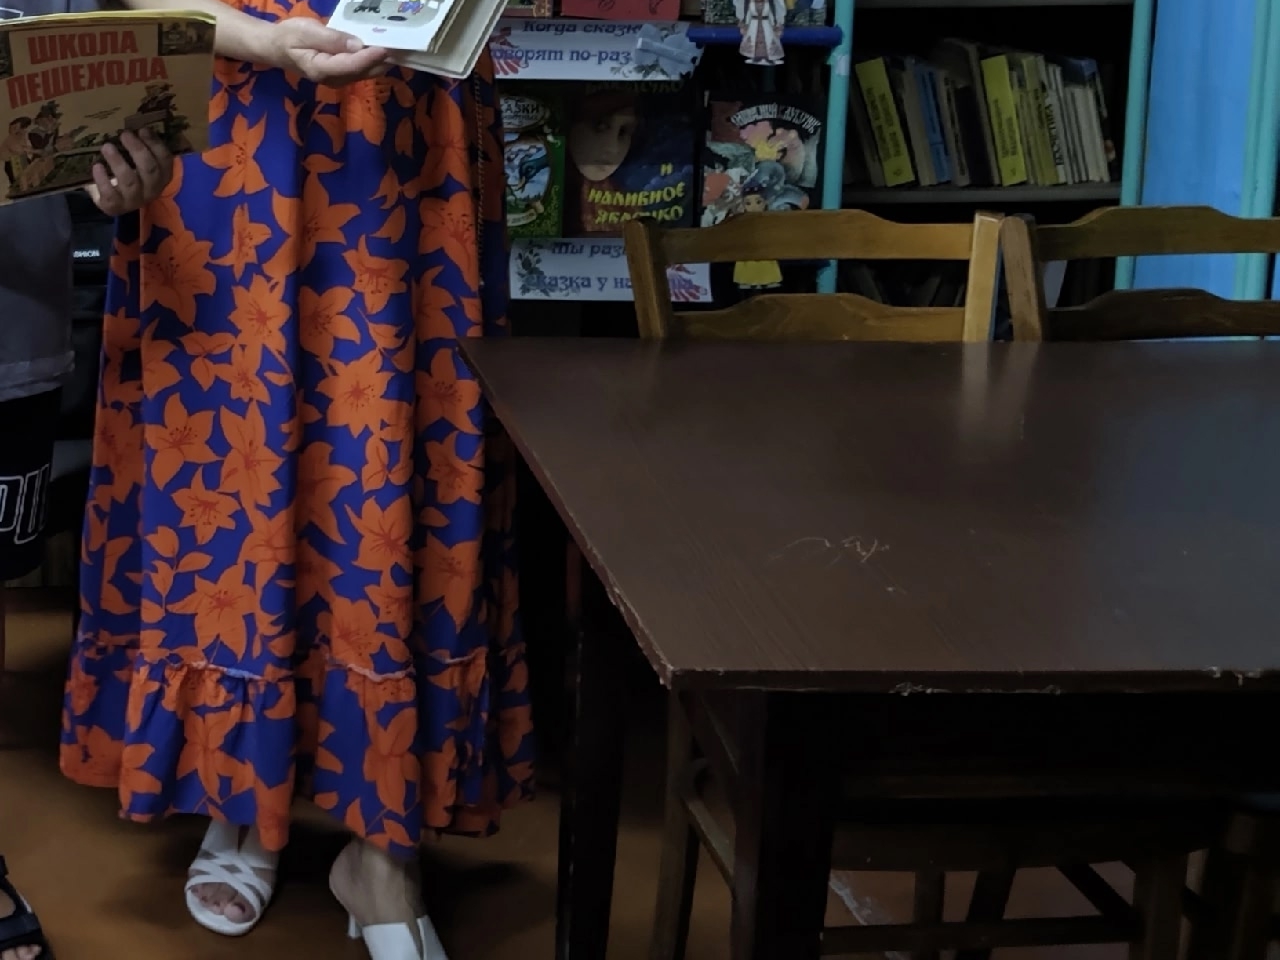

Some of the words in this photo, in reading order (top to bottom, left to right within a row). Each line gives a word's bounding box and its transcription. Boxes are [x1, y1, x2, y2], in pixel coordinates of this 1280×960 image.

[521, 19, 578, 36] Когда
[27, 30, 139, 65] ШКОЛА
[492, 48, 564, 68] оворят
[6, 56, 169, 110] ПЕШЕХОДА
[587, 181, 687, 208] НАЛИВНОЕ
